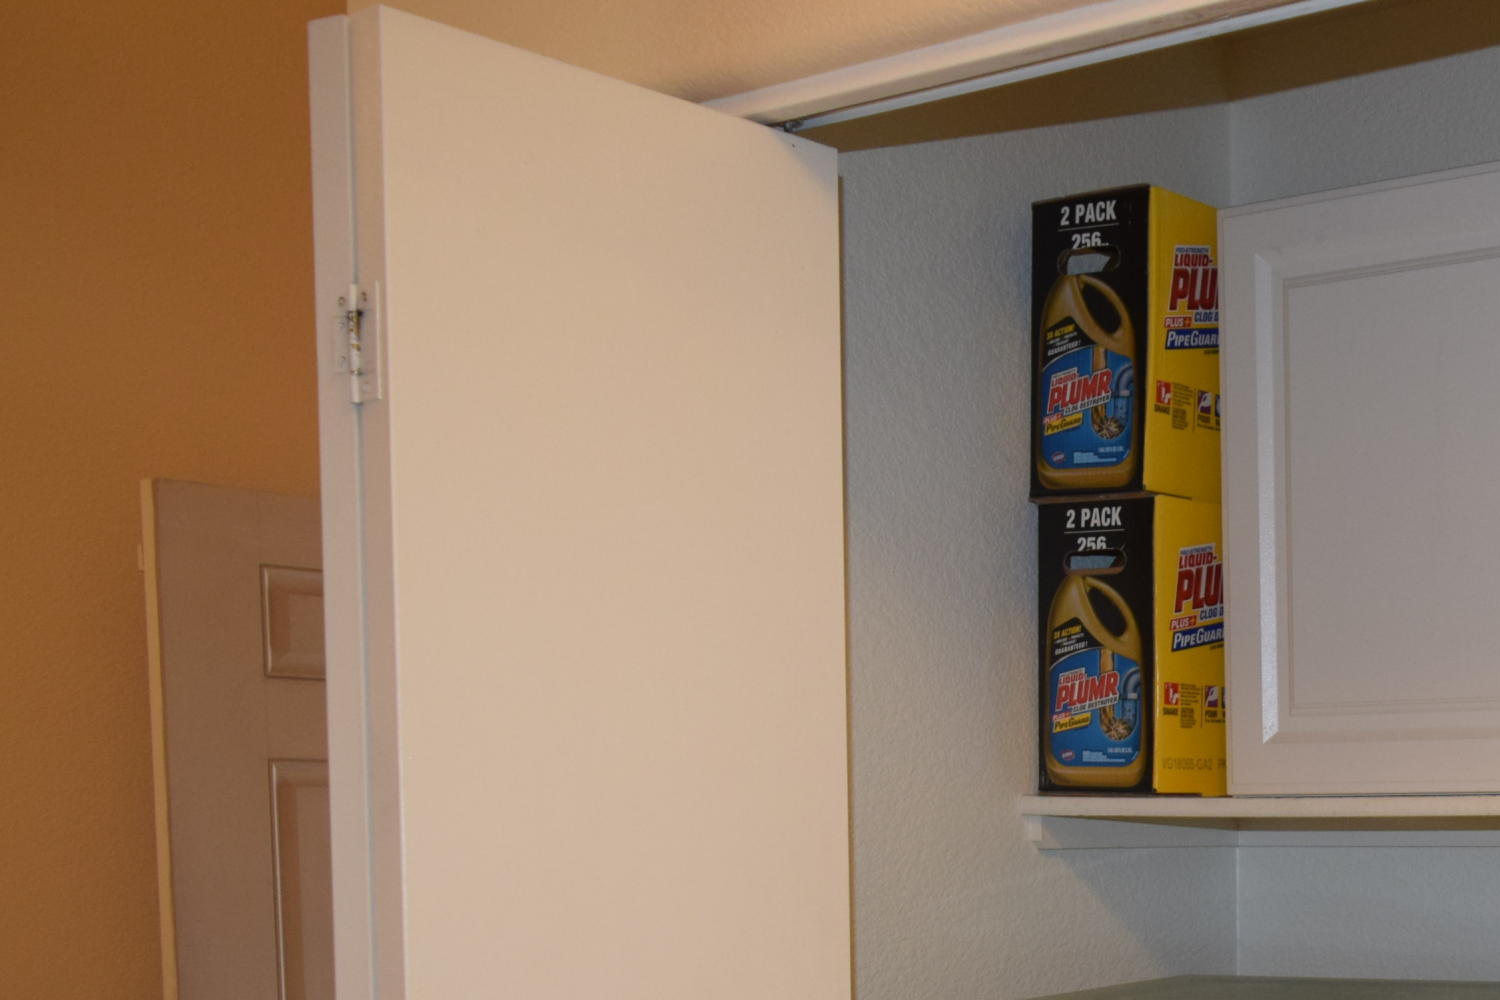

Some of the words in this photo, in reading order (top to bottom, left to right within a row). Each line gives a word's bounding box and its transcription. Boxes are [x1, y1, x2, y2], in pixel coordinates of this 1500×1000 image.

[1060, 205, 1070, 226] 2
[1075, 199, 1117, 224] PACK
[1071, 231, 1102, 250] 256
[1169, 267, 1219, 311] PLU
[1195, 311, 1213, 323] CLOG
[1167, 330, 1219, 348] PIPEGUAR
[1048, 369, 1111, 412] PLUMR
[1065, 509, 1076, 528] 2
[1080, 505, 1122, 528] PACK
[1077, 536, 1107, 552] 256
[1174, 563, 1223, 614] PLU
[1200, 607, 1218, 620] CLOG
[1173, 627, 1224, 649] PIPEGUAR
[1056, 671, 1119, 710] PLUMR
